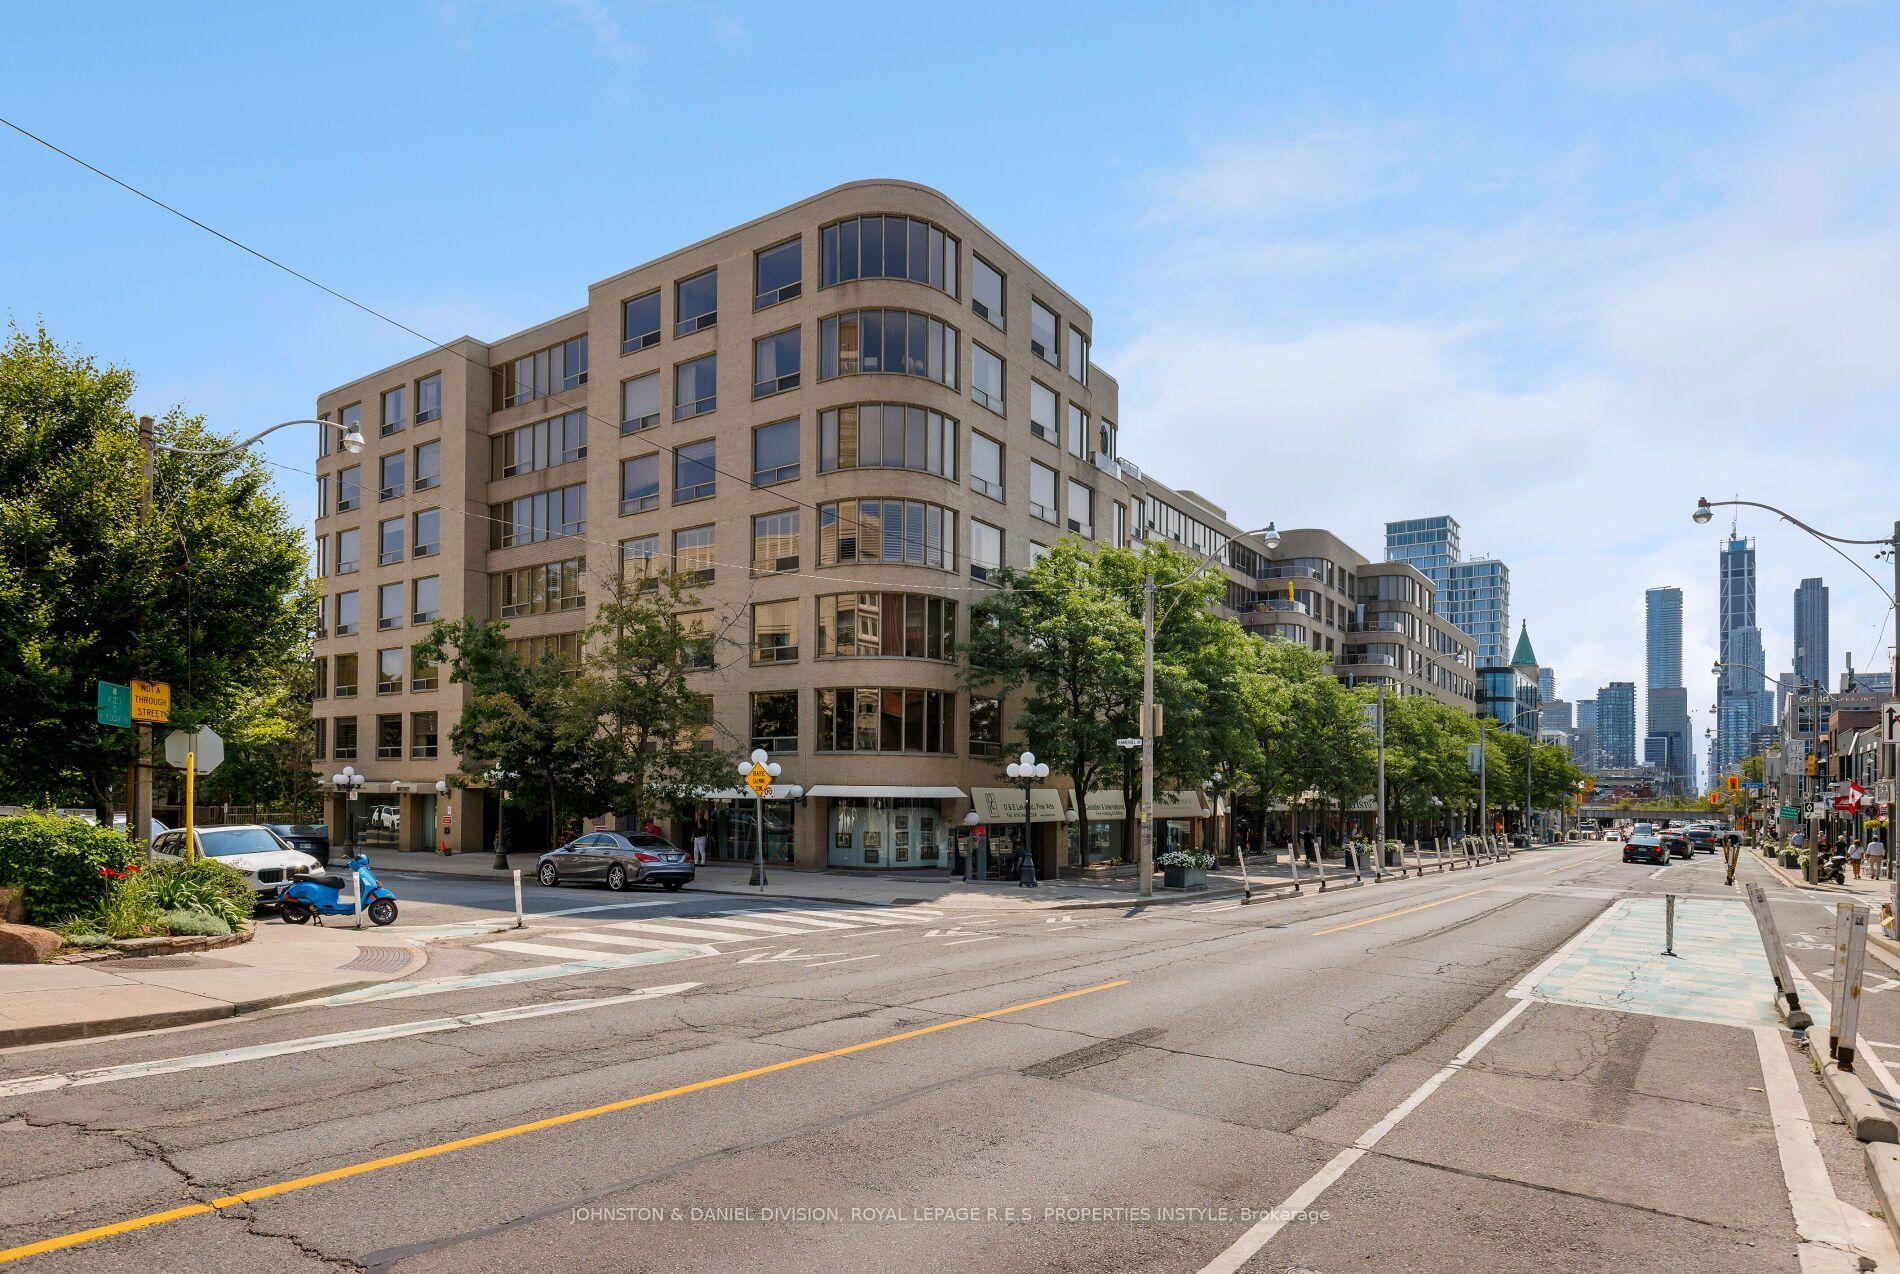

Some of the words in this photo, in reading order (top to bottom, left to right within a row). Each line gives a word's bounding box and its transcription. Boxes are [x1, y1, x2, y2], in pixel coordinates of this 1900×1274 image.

[141, 683, 154, 693] NOT
[156, 686, 161, 694] A
[135, 695, 167, 706] THROUGH
[138, 707, 164, 718] STREET
